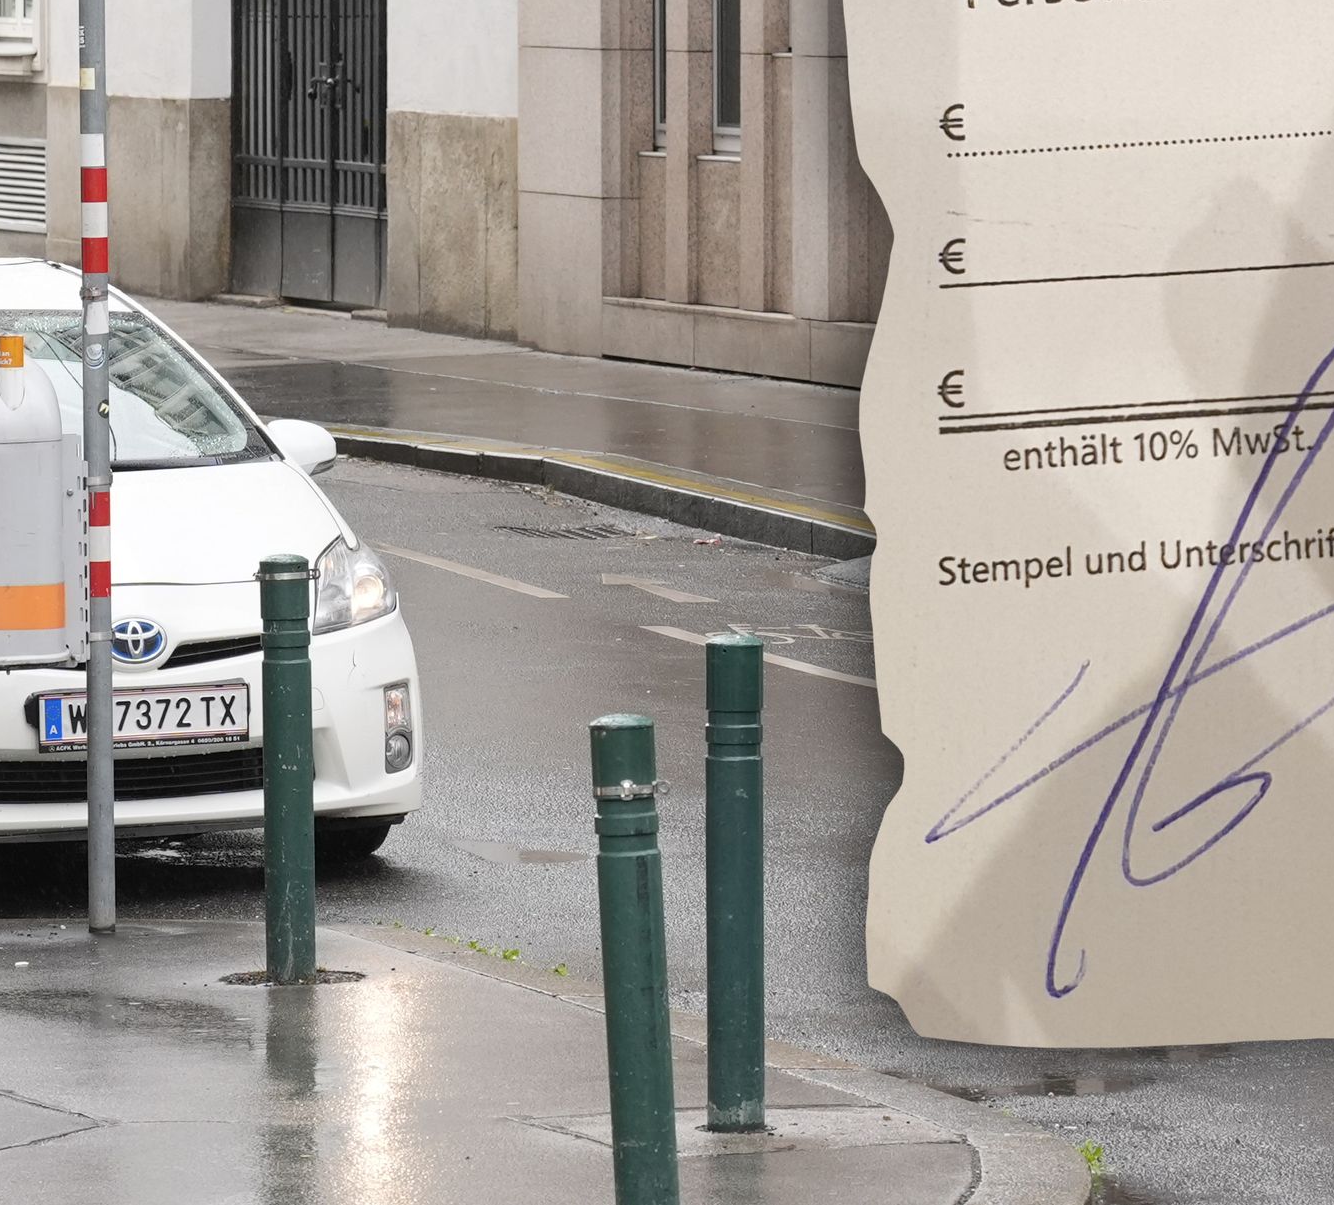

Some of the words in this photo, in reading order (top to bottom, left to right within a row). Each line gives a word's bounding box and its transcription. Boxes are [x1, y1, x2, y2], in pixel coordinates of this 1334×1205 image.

[938, 103, 966, 142] €
[937, 237, 967, 275] €
[936, 369, 966, 409] €
[1002, 430, 1124, 473] enthält
[1133, 428, 1199, 463] 10%
[1209, 425, 1319, 464] MwSt.
[938, 545, 1072, 589] Stempel
[1085, 545, 1147, 576] und
[50, 725, 58, 735] A
[69, 704, 87, 734] W
[115, 697, 192, 732] 7372
[199, 695, 237, 728] TX
